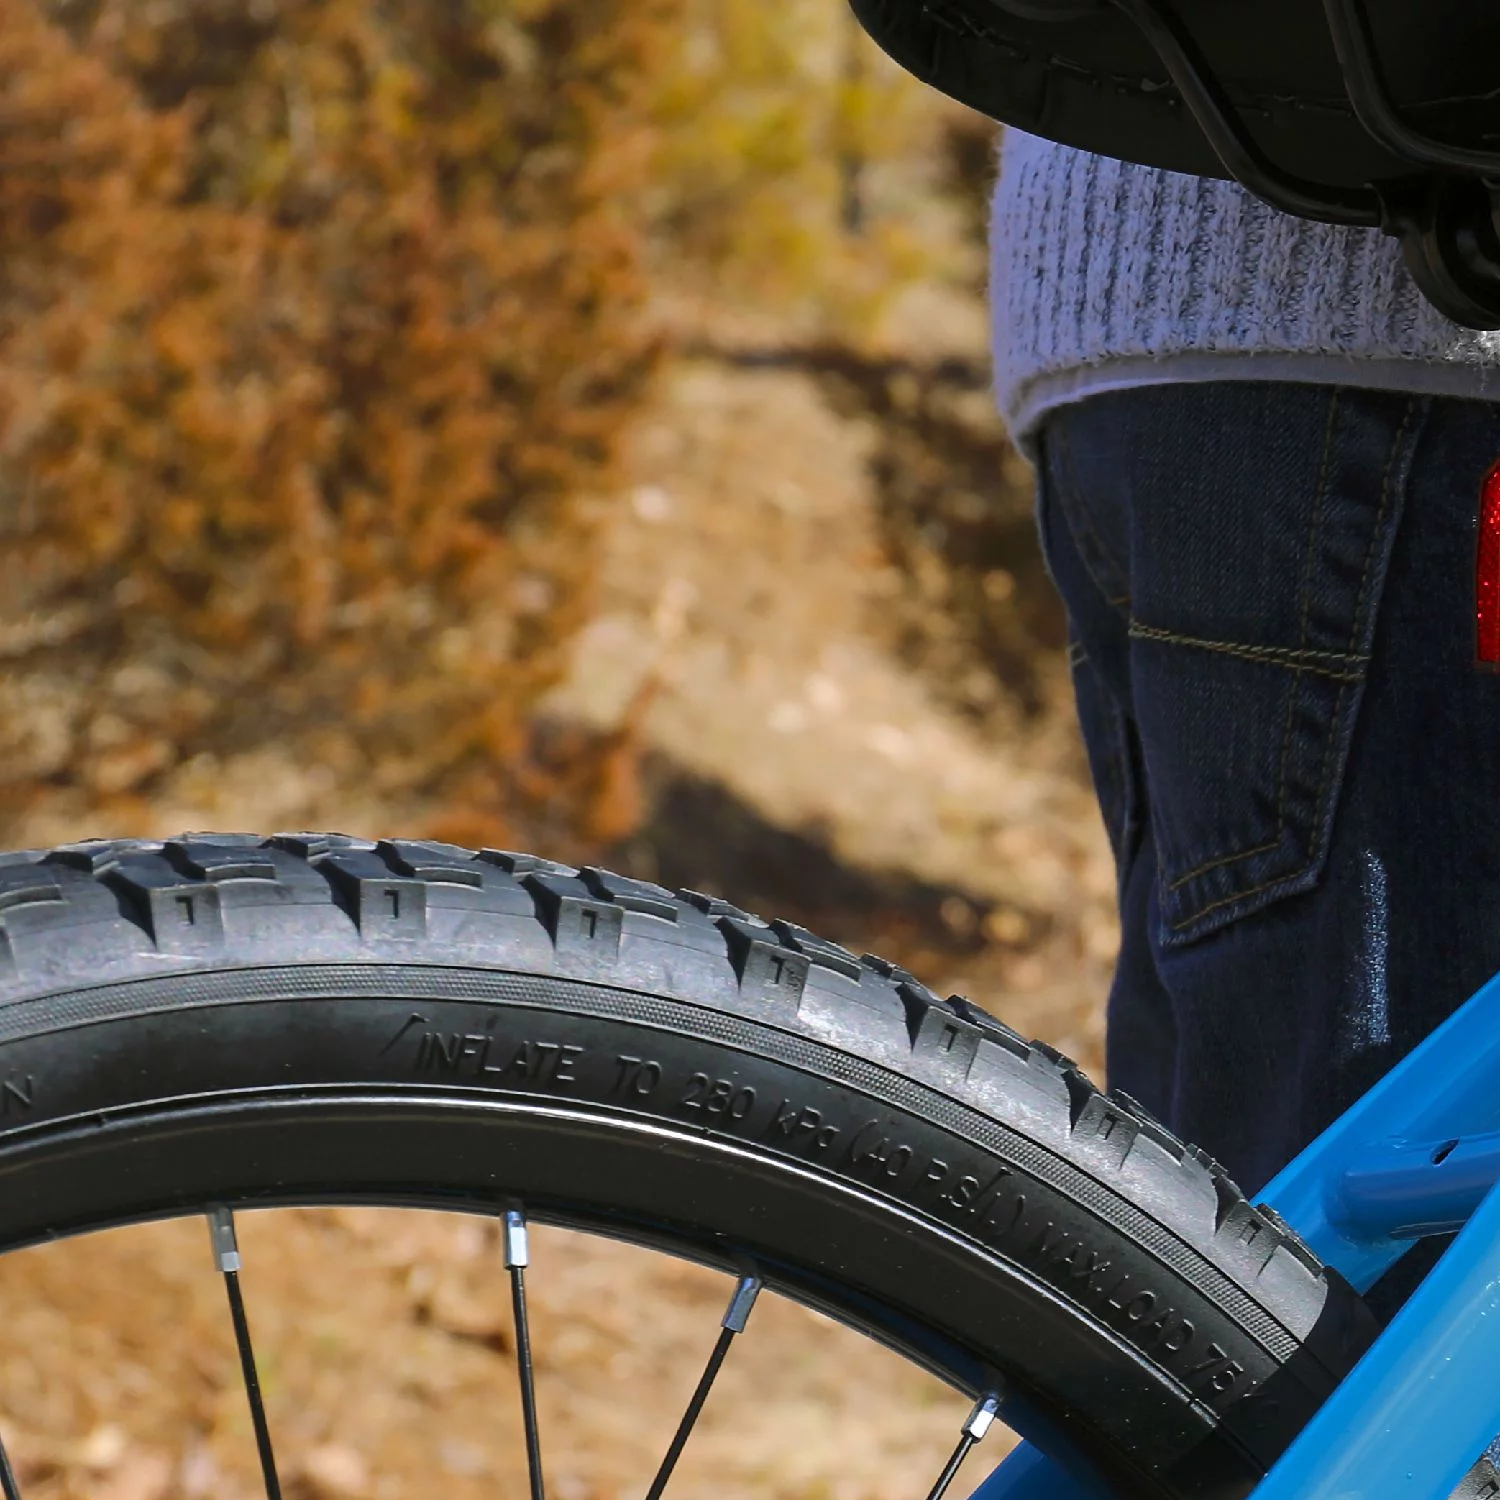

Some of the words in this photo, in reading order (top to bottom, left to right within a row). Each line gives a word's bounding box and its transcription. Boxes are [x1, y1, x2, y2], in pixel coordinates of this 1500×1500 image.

[414, 1031, 585, 1082] INFLATE
[608, 1054, 663, 1098] TO
[682, 1070, 758, 1120] 280
